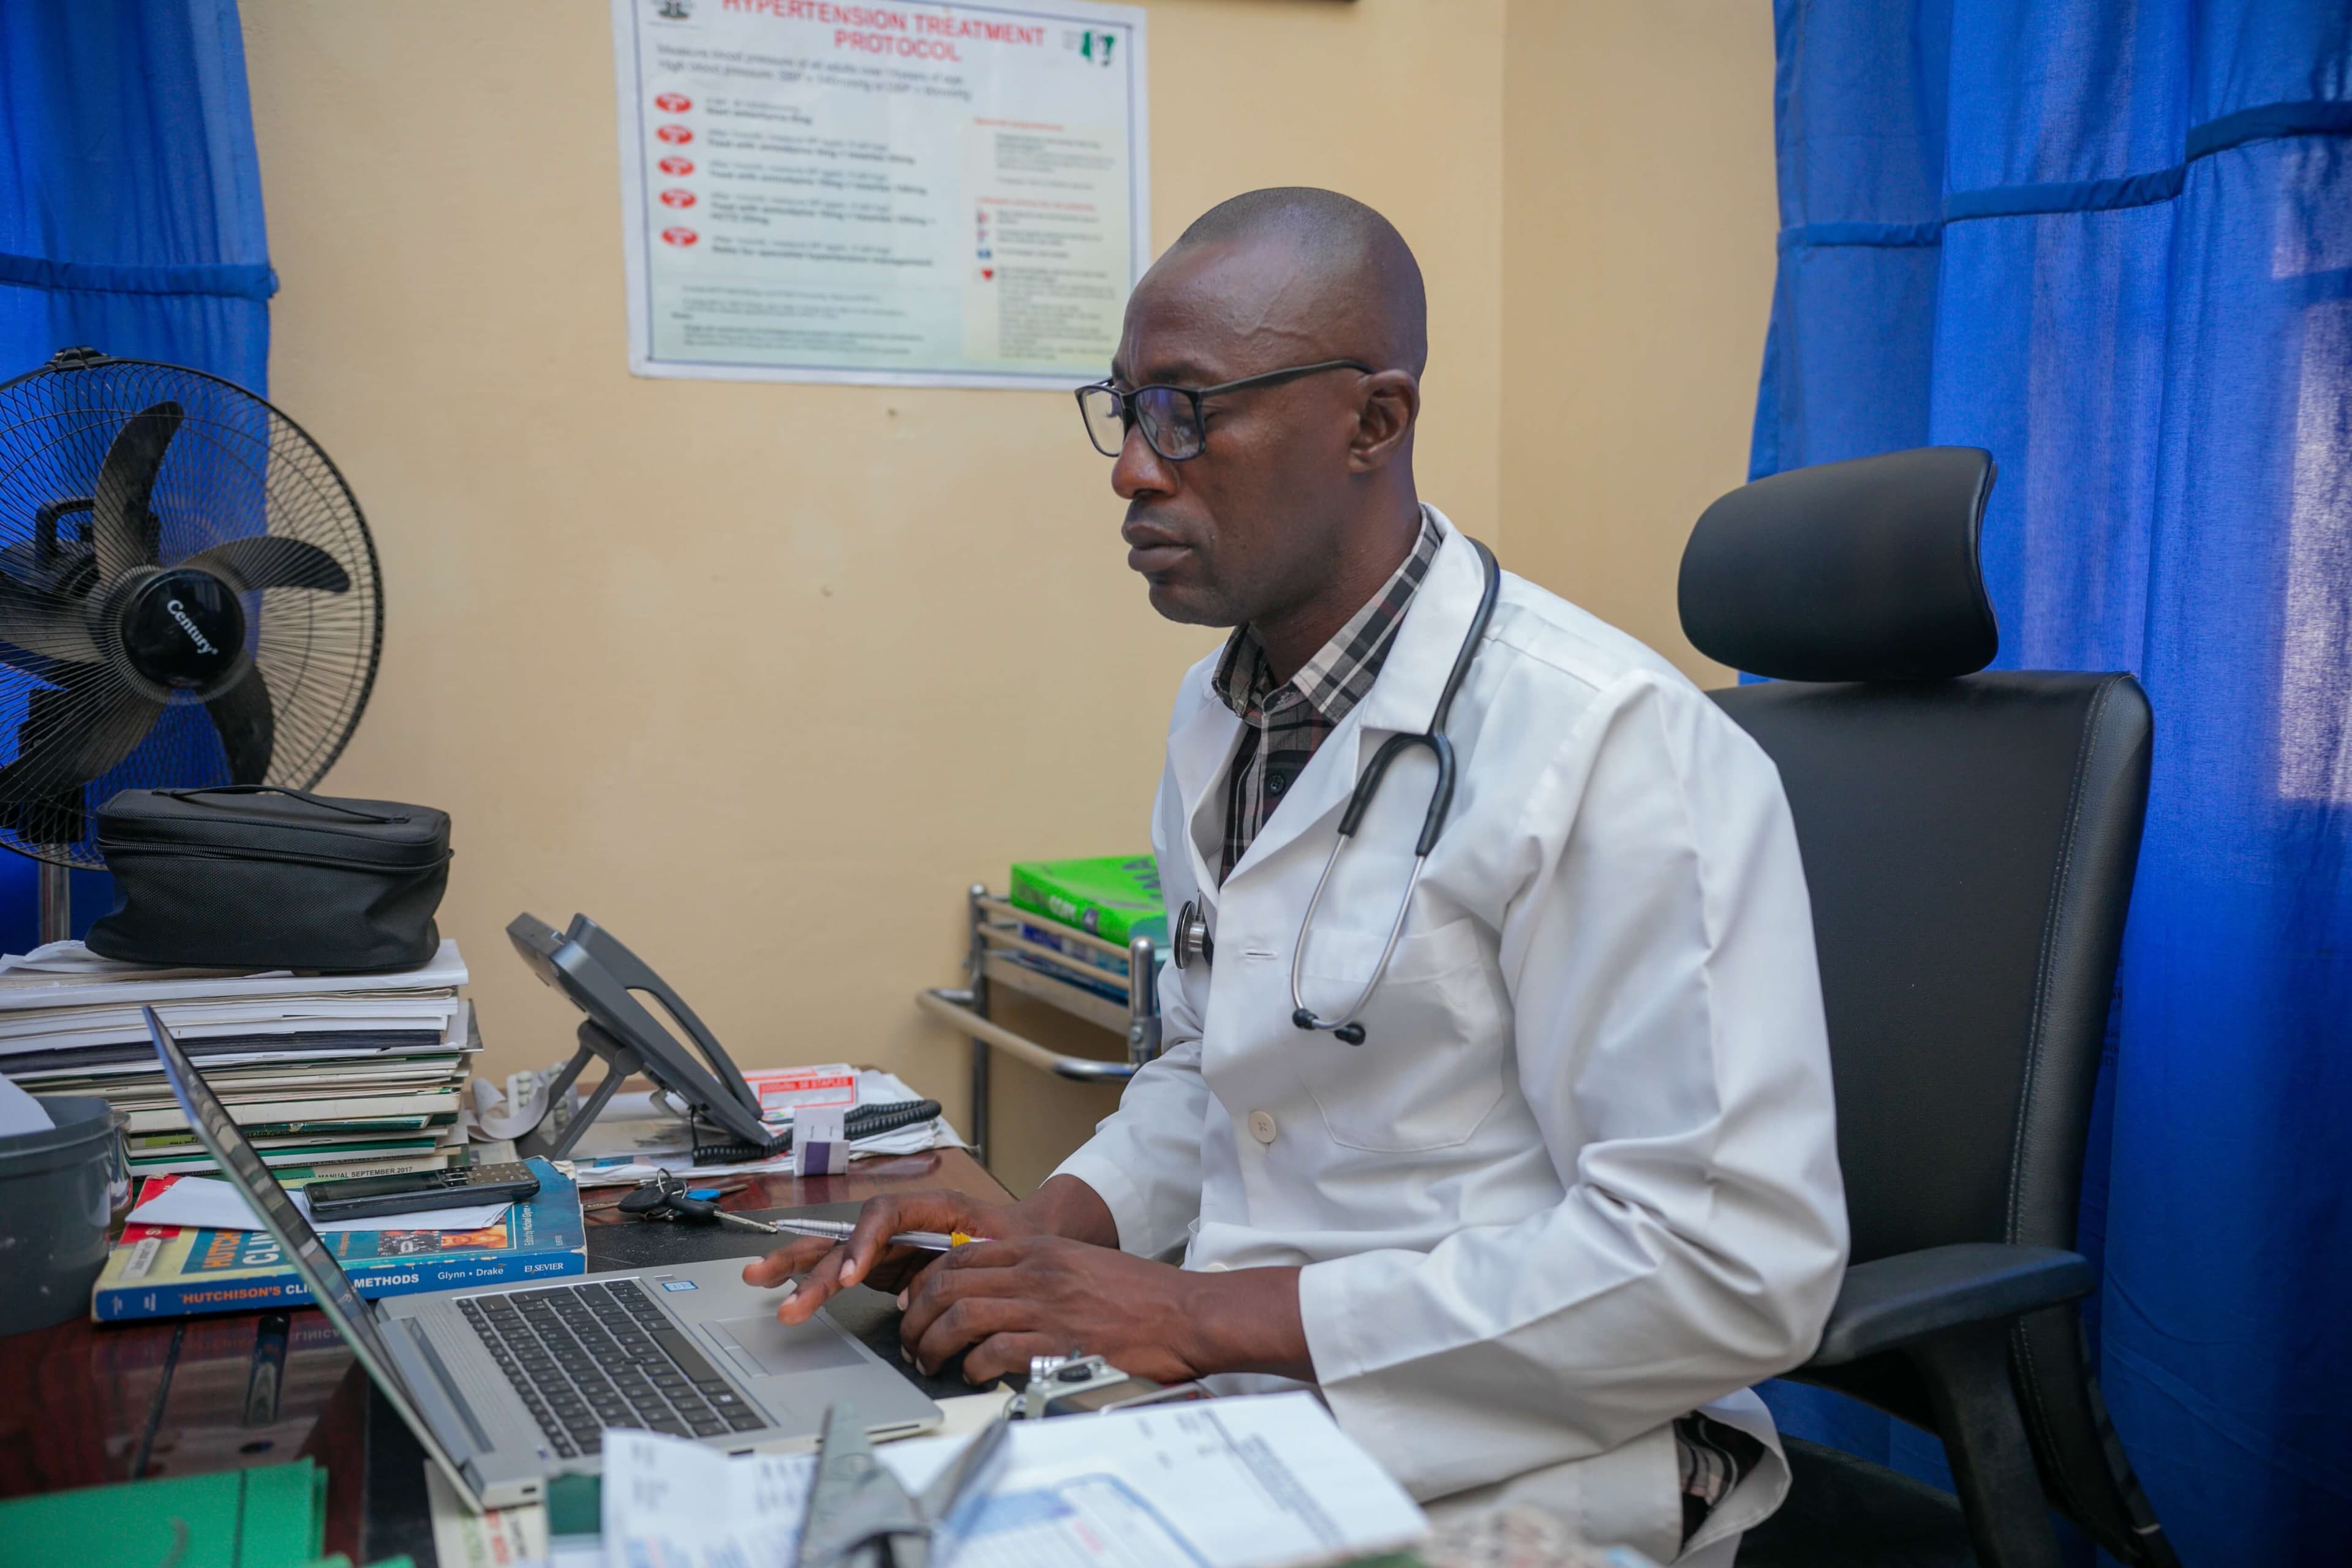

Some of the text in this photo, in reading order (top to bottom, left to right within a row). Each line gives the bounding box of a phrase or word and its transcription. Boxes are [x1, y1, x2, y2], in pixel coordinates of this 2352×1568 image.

[722, 0, 906, 31] HYPERTENSION
[913, 13, 1045, 47] TREATMENT
[834, 29, 962, 62] PROTOCOL
[167, 600, 213, 654] Century
[351, 1168, 396, 1177] SEPTEMBER
[437, 1266, 504, 1281] Glynn Drake
[524, 1262, 564, 1273] ELSEVIER
[183, 1286, 281, 1305] HUTCHISON'S
[353, 1273, 420, 1289] METHODS
